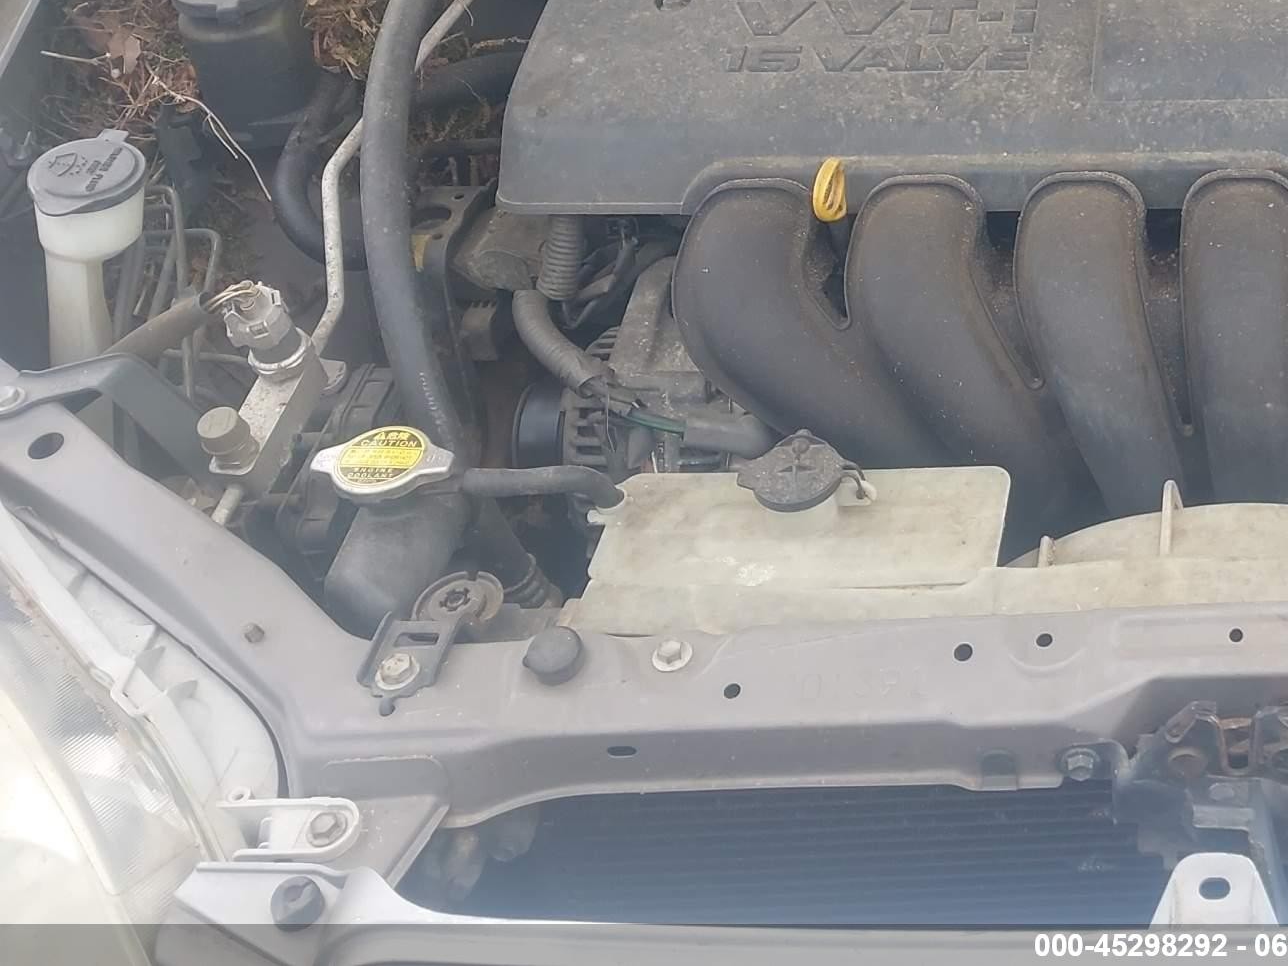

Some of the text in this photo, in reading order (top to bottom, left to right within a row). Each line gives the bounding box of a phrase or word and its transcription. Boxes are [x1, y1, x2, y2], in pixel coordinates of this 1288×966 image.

[724, 44, 1032, 73] 16 VALVE
[360, 439, 418, 448] CAUTION
